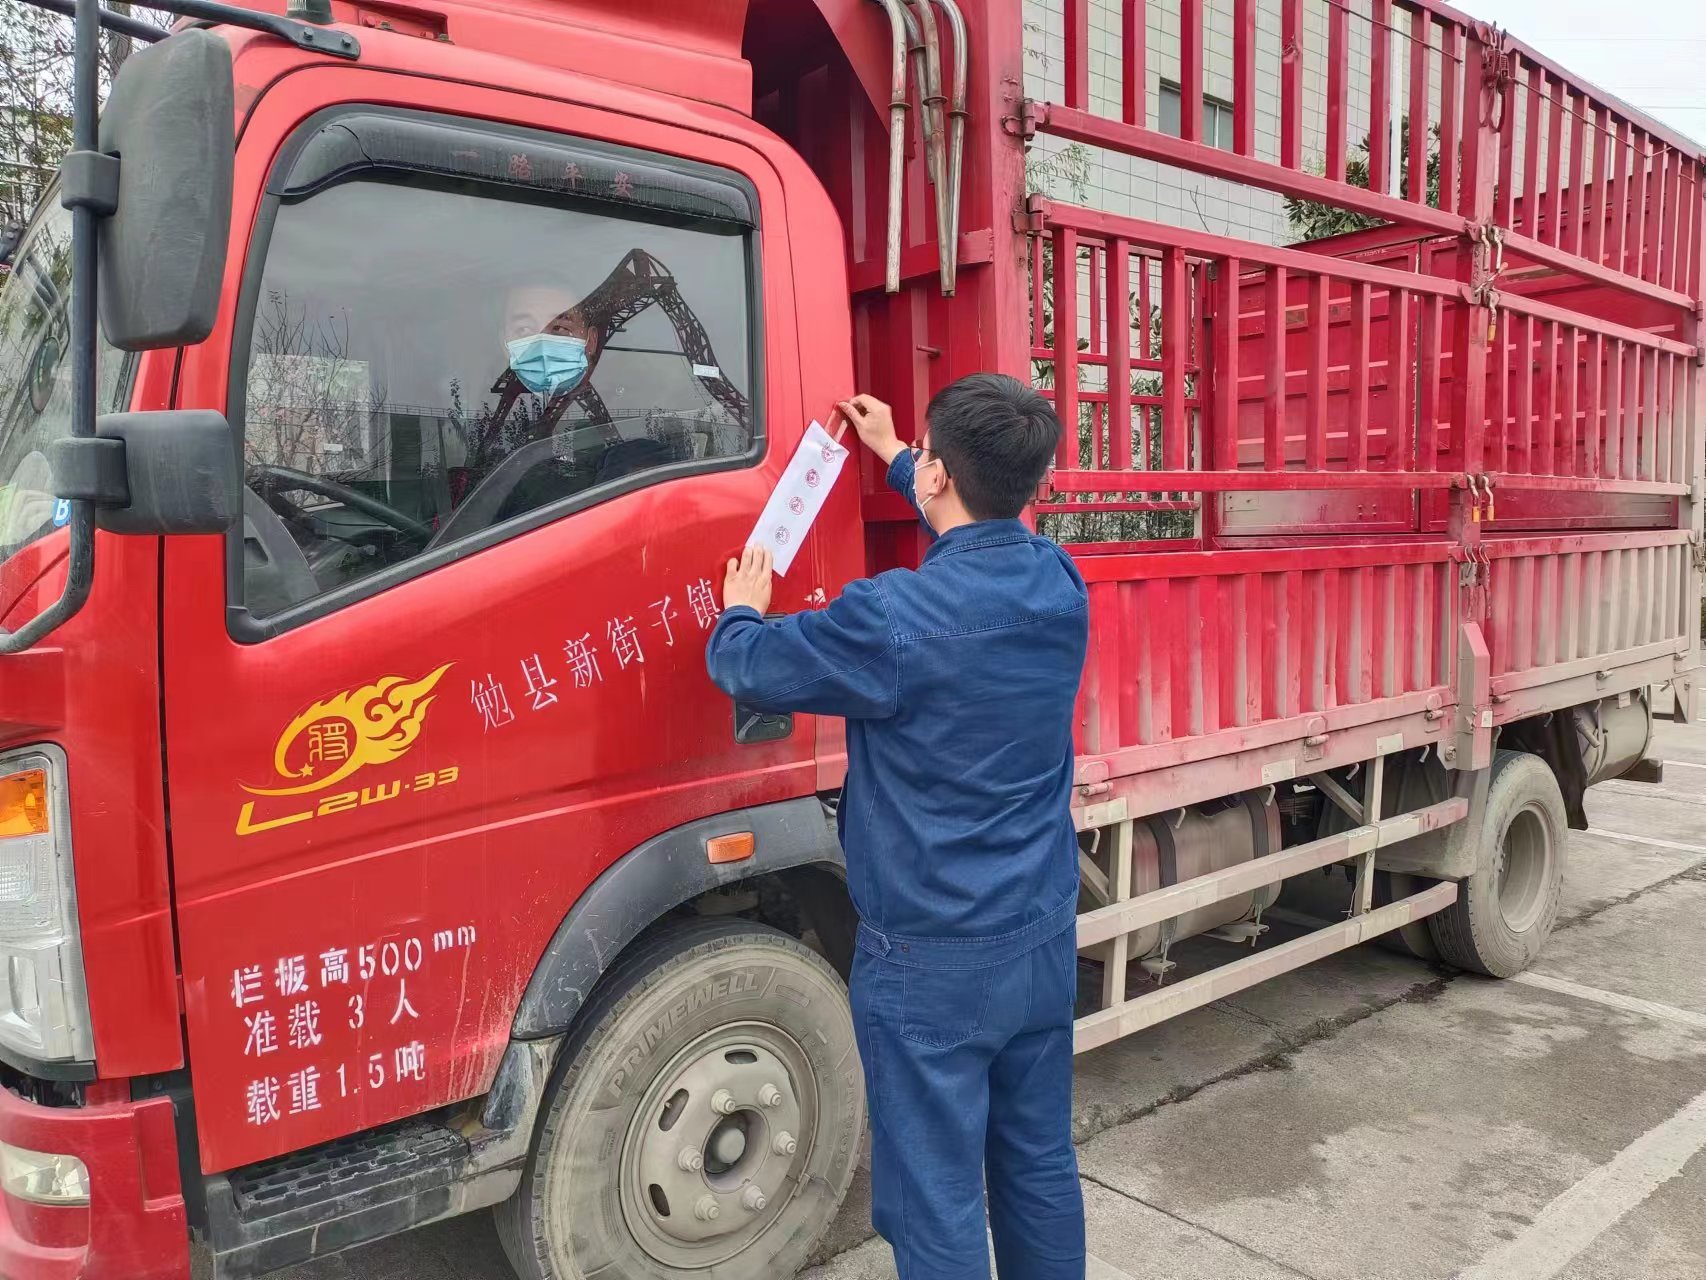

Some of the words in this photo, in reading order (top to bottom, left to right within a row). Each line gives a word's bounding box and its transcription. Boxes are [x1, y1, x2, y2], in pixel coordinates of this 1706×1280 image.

[471, 578, 720, 735] 勉县新街子镇
[607, 973, 758, 1098] PRIMEWELL
